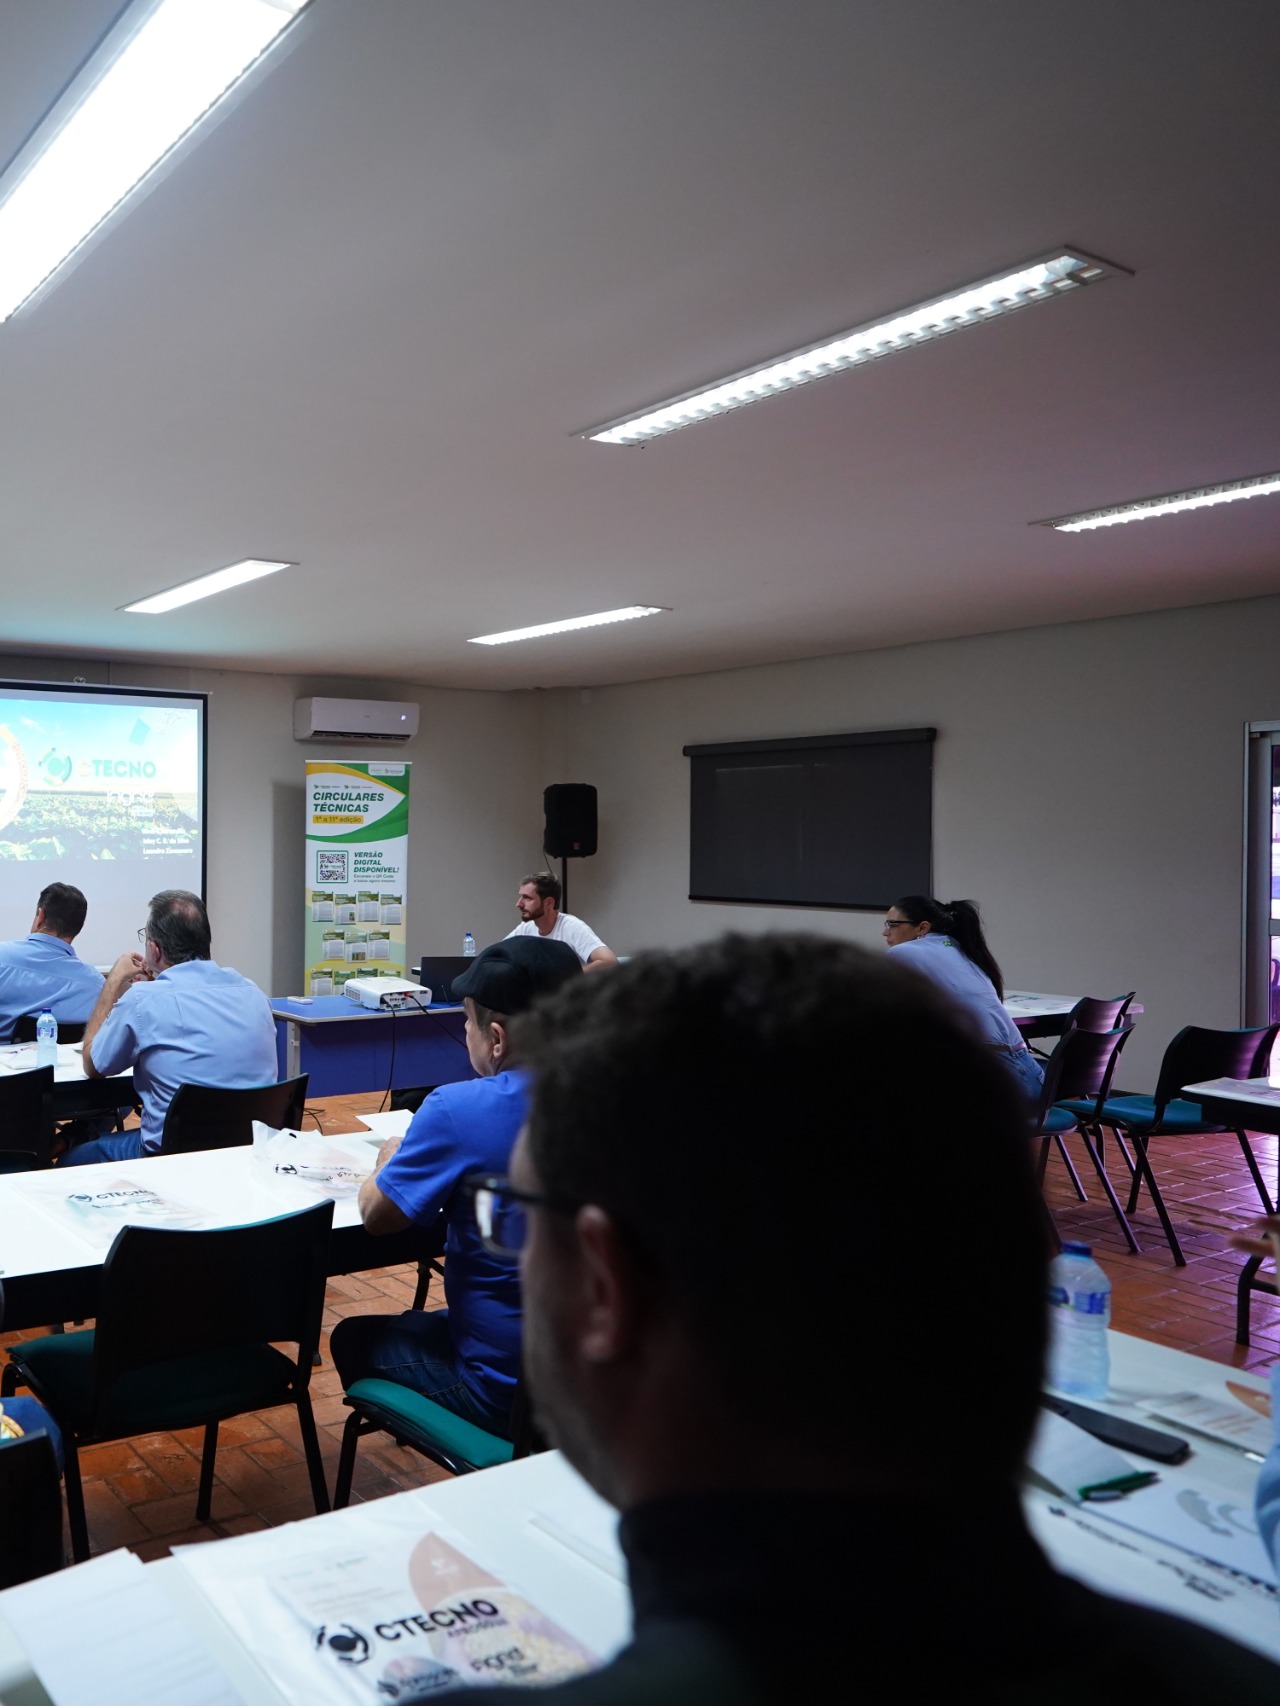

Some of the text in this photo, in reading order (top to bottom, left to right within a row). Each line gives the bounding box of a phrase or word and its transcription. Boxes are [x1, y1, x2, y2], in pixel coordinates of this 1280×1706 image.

[77, 758, 156, 778] CTECNO
[313, 792, 384, 802] CIRCULARES
[313, 802, 369, 813] TÉCNICAS
[374, 1598, 499, 1642] CTECNO
